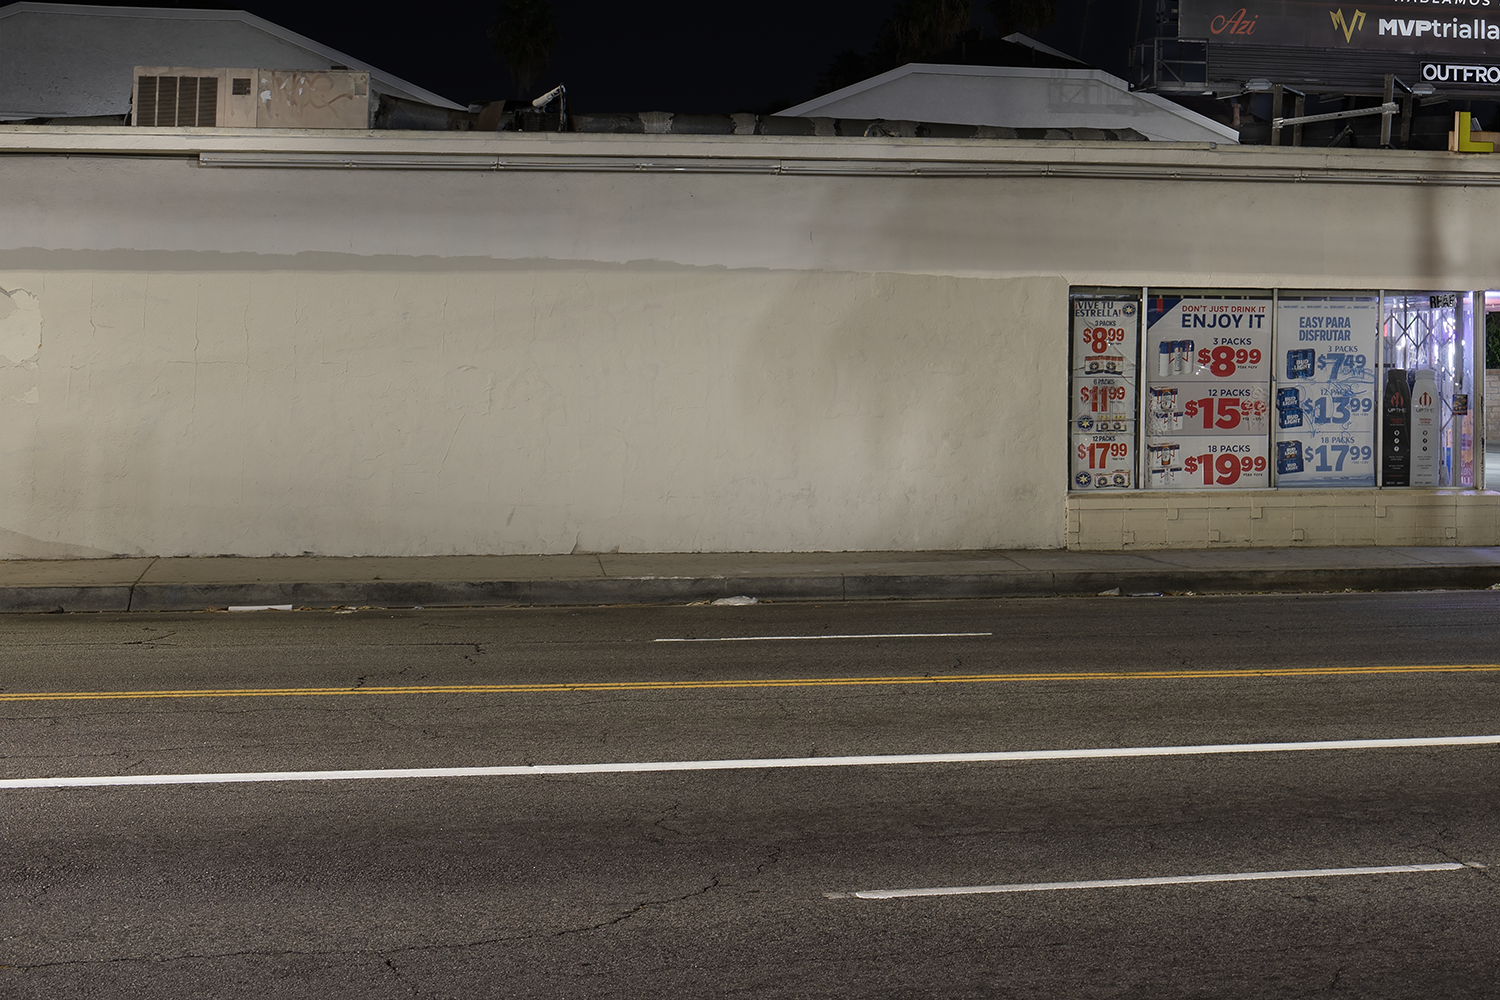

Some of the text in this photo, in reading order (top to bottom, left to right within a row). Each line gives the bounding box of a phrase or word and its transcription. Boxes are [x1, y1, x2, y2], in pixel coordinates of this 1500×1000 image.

[1210, 8, 1259, 35] Azi
[1101, 301, 1114, 309] TU
[1209, 305, 1229, 313] JUST
[1075, 309, 1121, 317] ESTRELLA!
[1181, 313, 1265, 329] ENJOY IT
[1299, 316, 1351, 328] EASY PARA
[1299, 329, 1351, 341] DISFRUTAR
[1208, 389, 1251, 397] 12 PACKS
